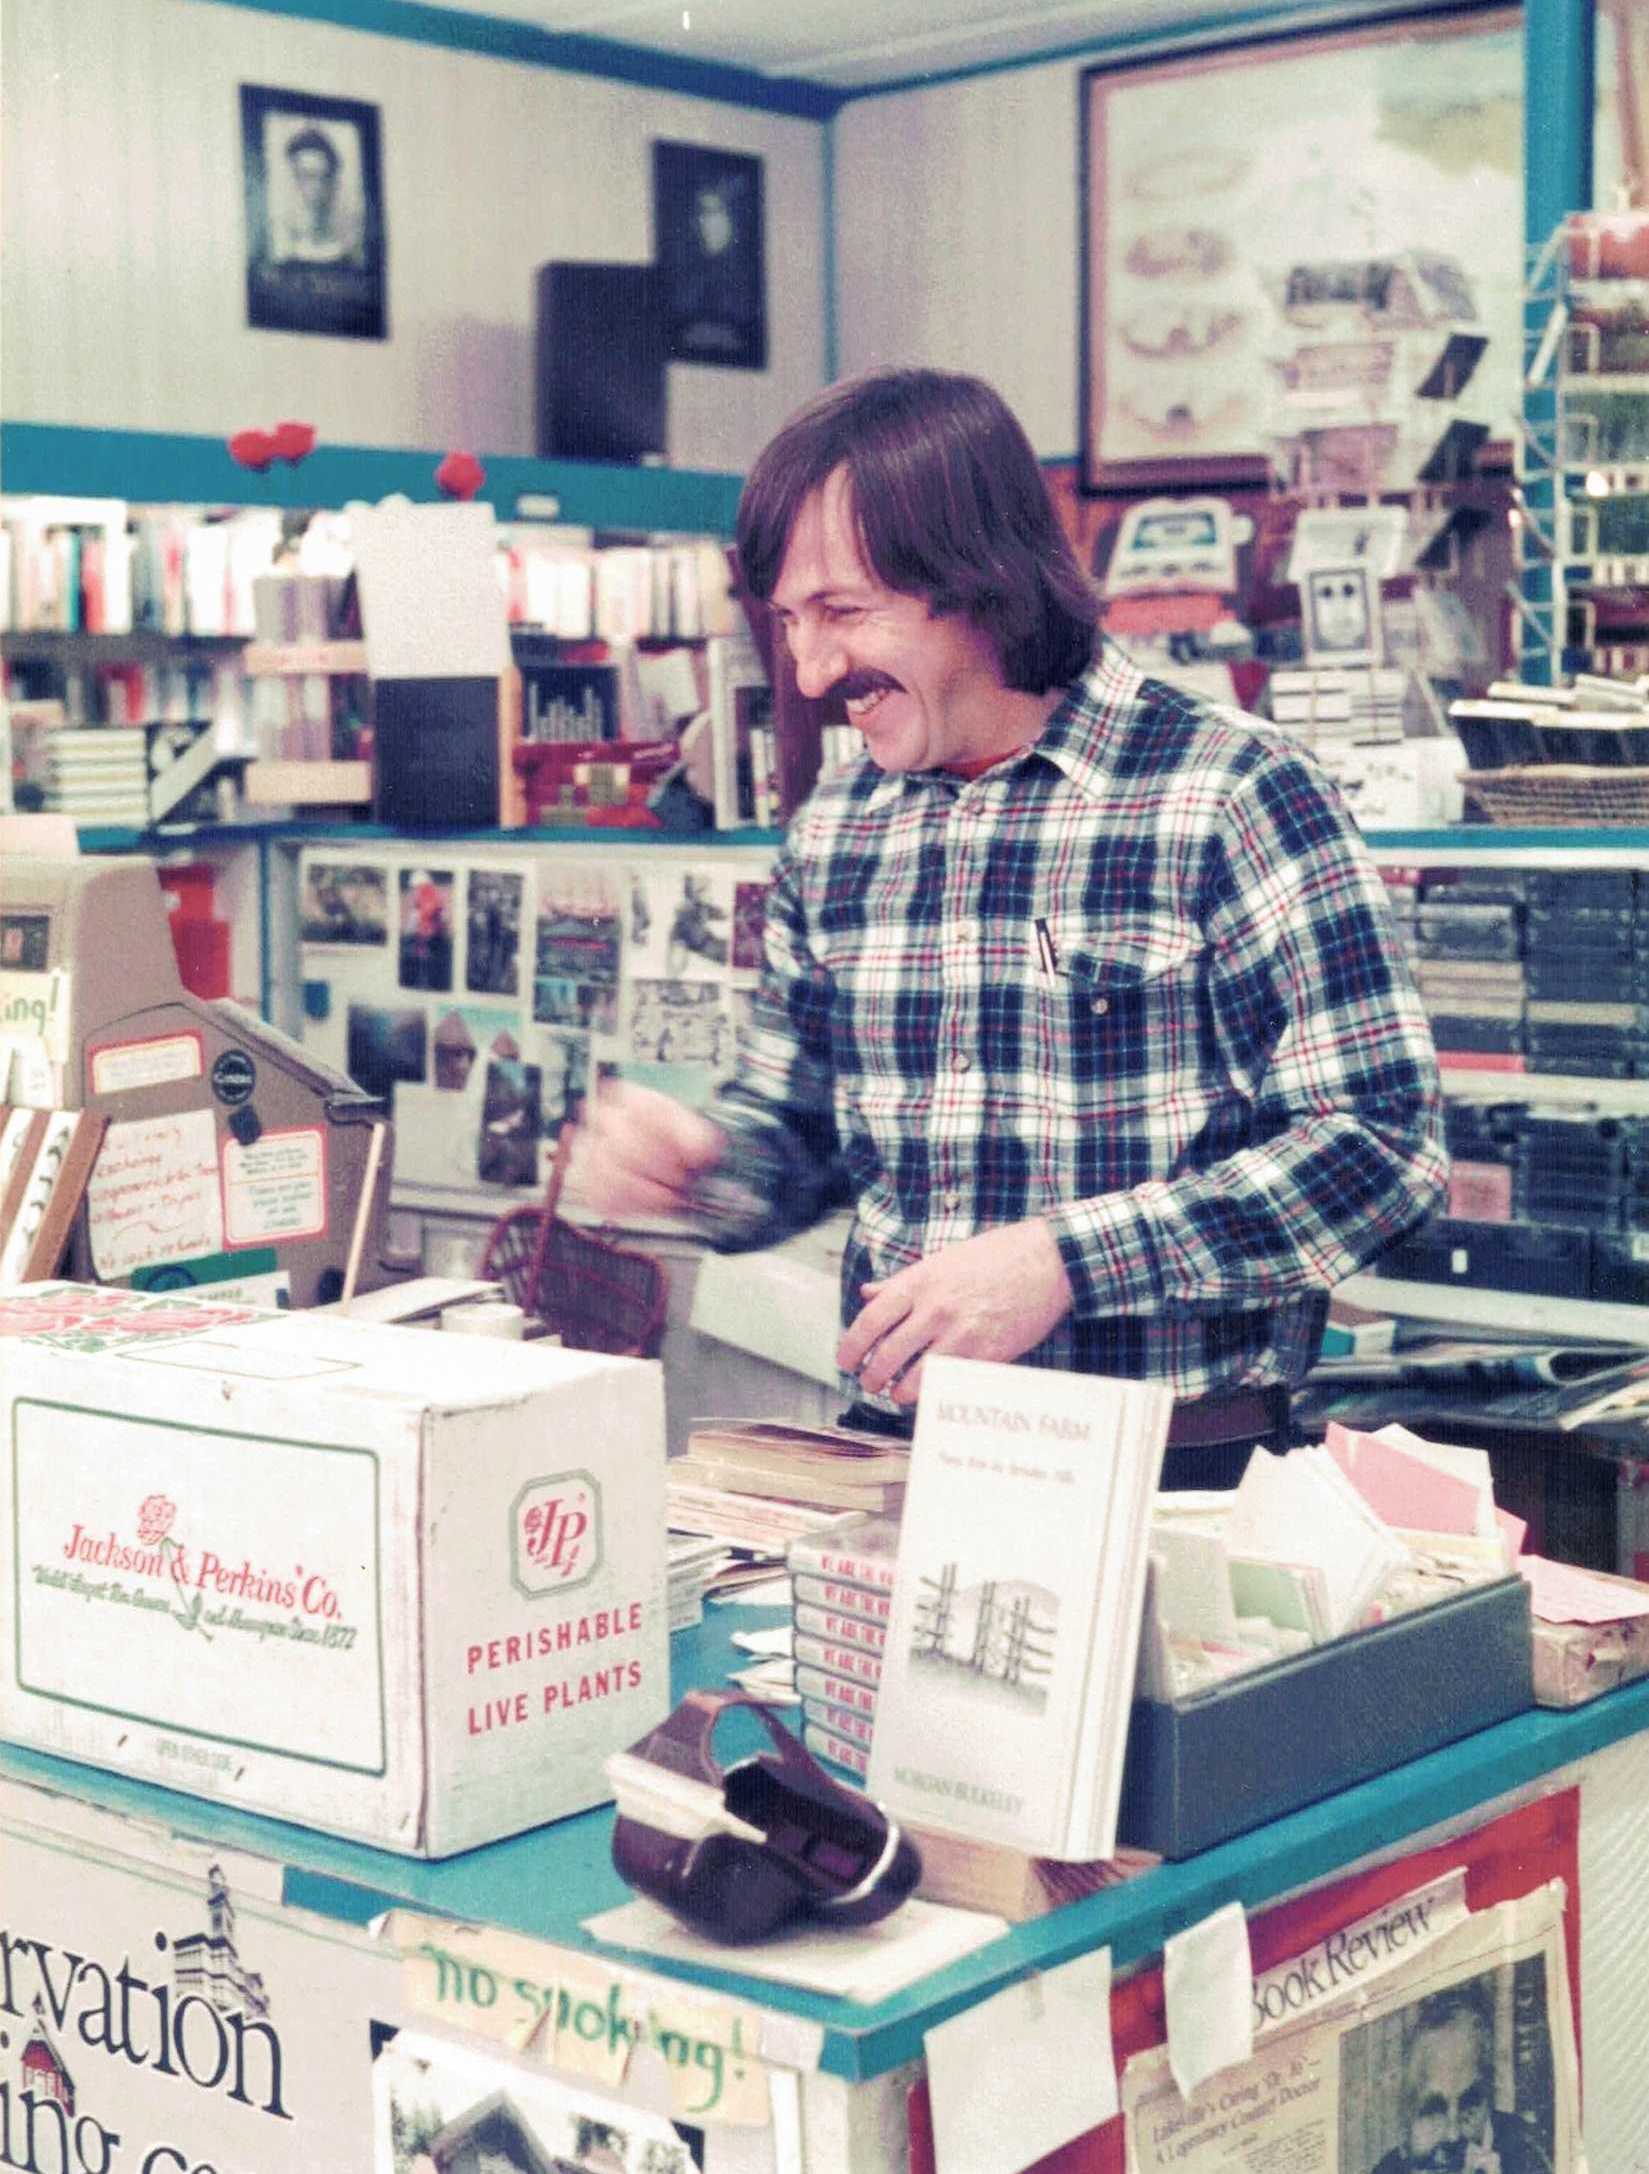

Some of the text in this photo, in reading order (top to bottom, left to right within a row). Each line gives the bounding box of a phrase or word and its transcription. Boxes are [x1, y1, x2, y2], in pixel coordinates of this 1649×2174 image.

[63, 1523, 163, 1578] Jackson
[169, 1543, 190, 1585] &
[302, 1575, 343, 1619] Co.
[467, 1602, 643, 1675] PERISHABLE
[468, 1660, 642, 1736] LIVE PLANTS
[418, 1942, 499, 2008] no
[1322, 1895, 1437, 1987] Review
